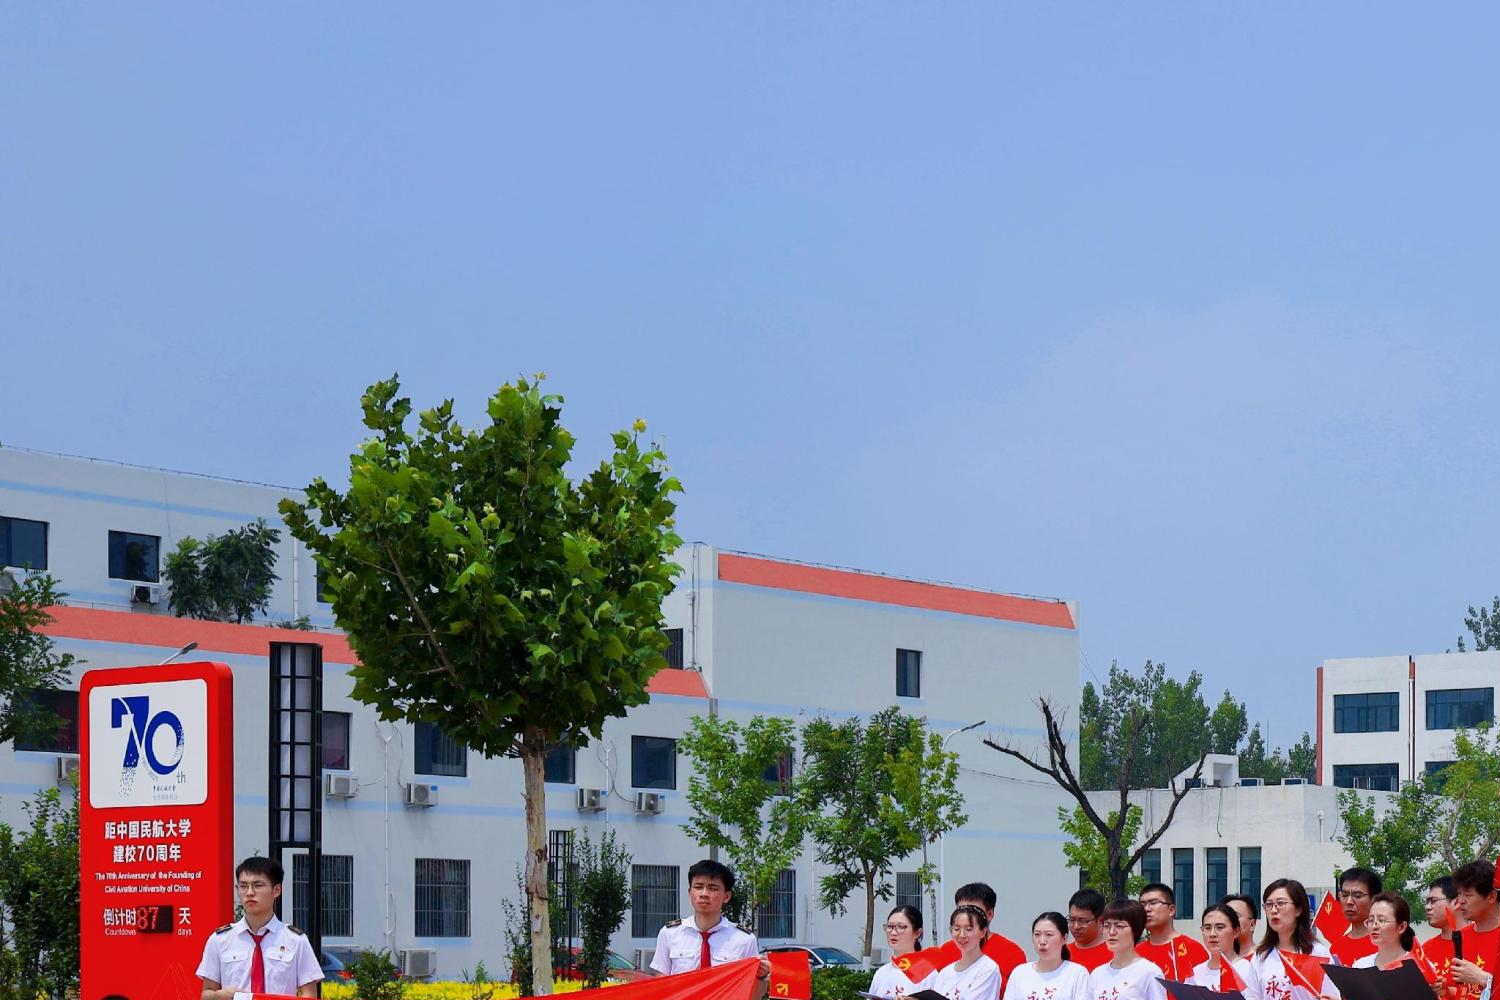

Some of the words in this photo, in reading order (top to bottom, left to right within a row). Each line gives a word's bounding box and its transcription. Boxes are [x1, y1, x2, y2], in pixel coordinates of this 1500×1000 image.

[105, 818, 191, 839] 距中国民航大学
[113, 843, 181, 863] 建校70周年
[118, 872, 150, 880] Anniversary
[168, 871, 194, 880] Founding
[105, 885, 116, 893] Civil
[117, 885, 138, 893] Aviation
[139, 885, 166, 894] University
[174, 884, 190, 893] China
[104, 907, 137, 926] 倒计时
[179, 907, 191, 925] 天
[105, 928, 137, 936] Countdown
[178, 928, 192, 936] days
